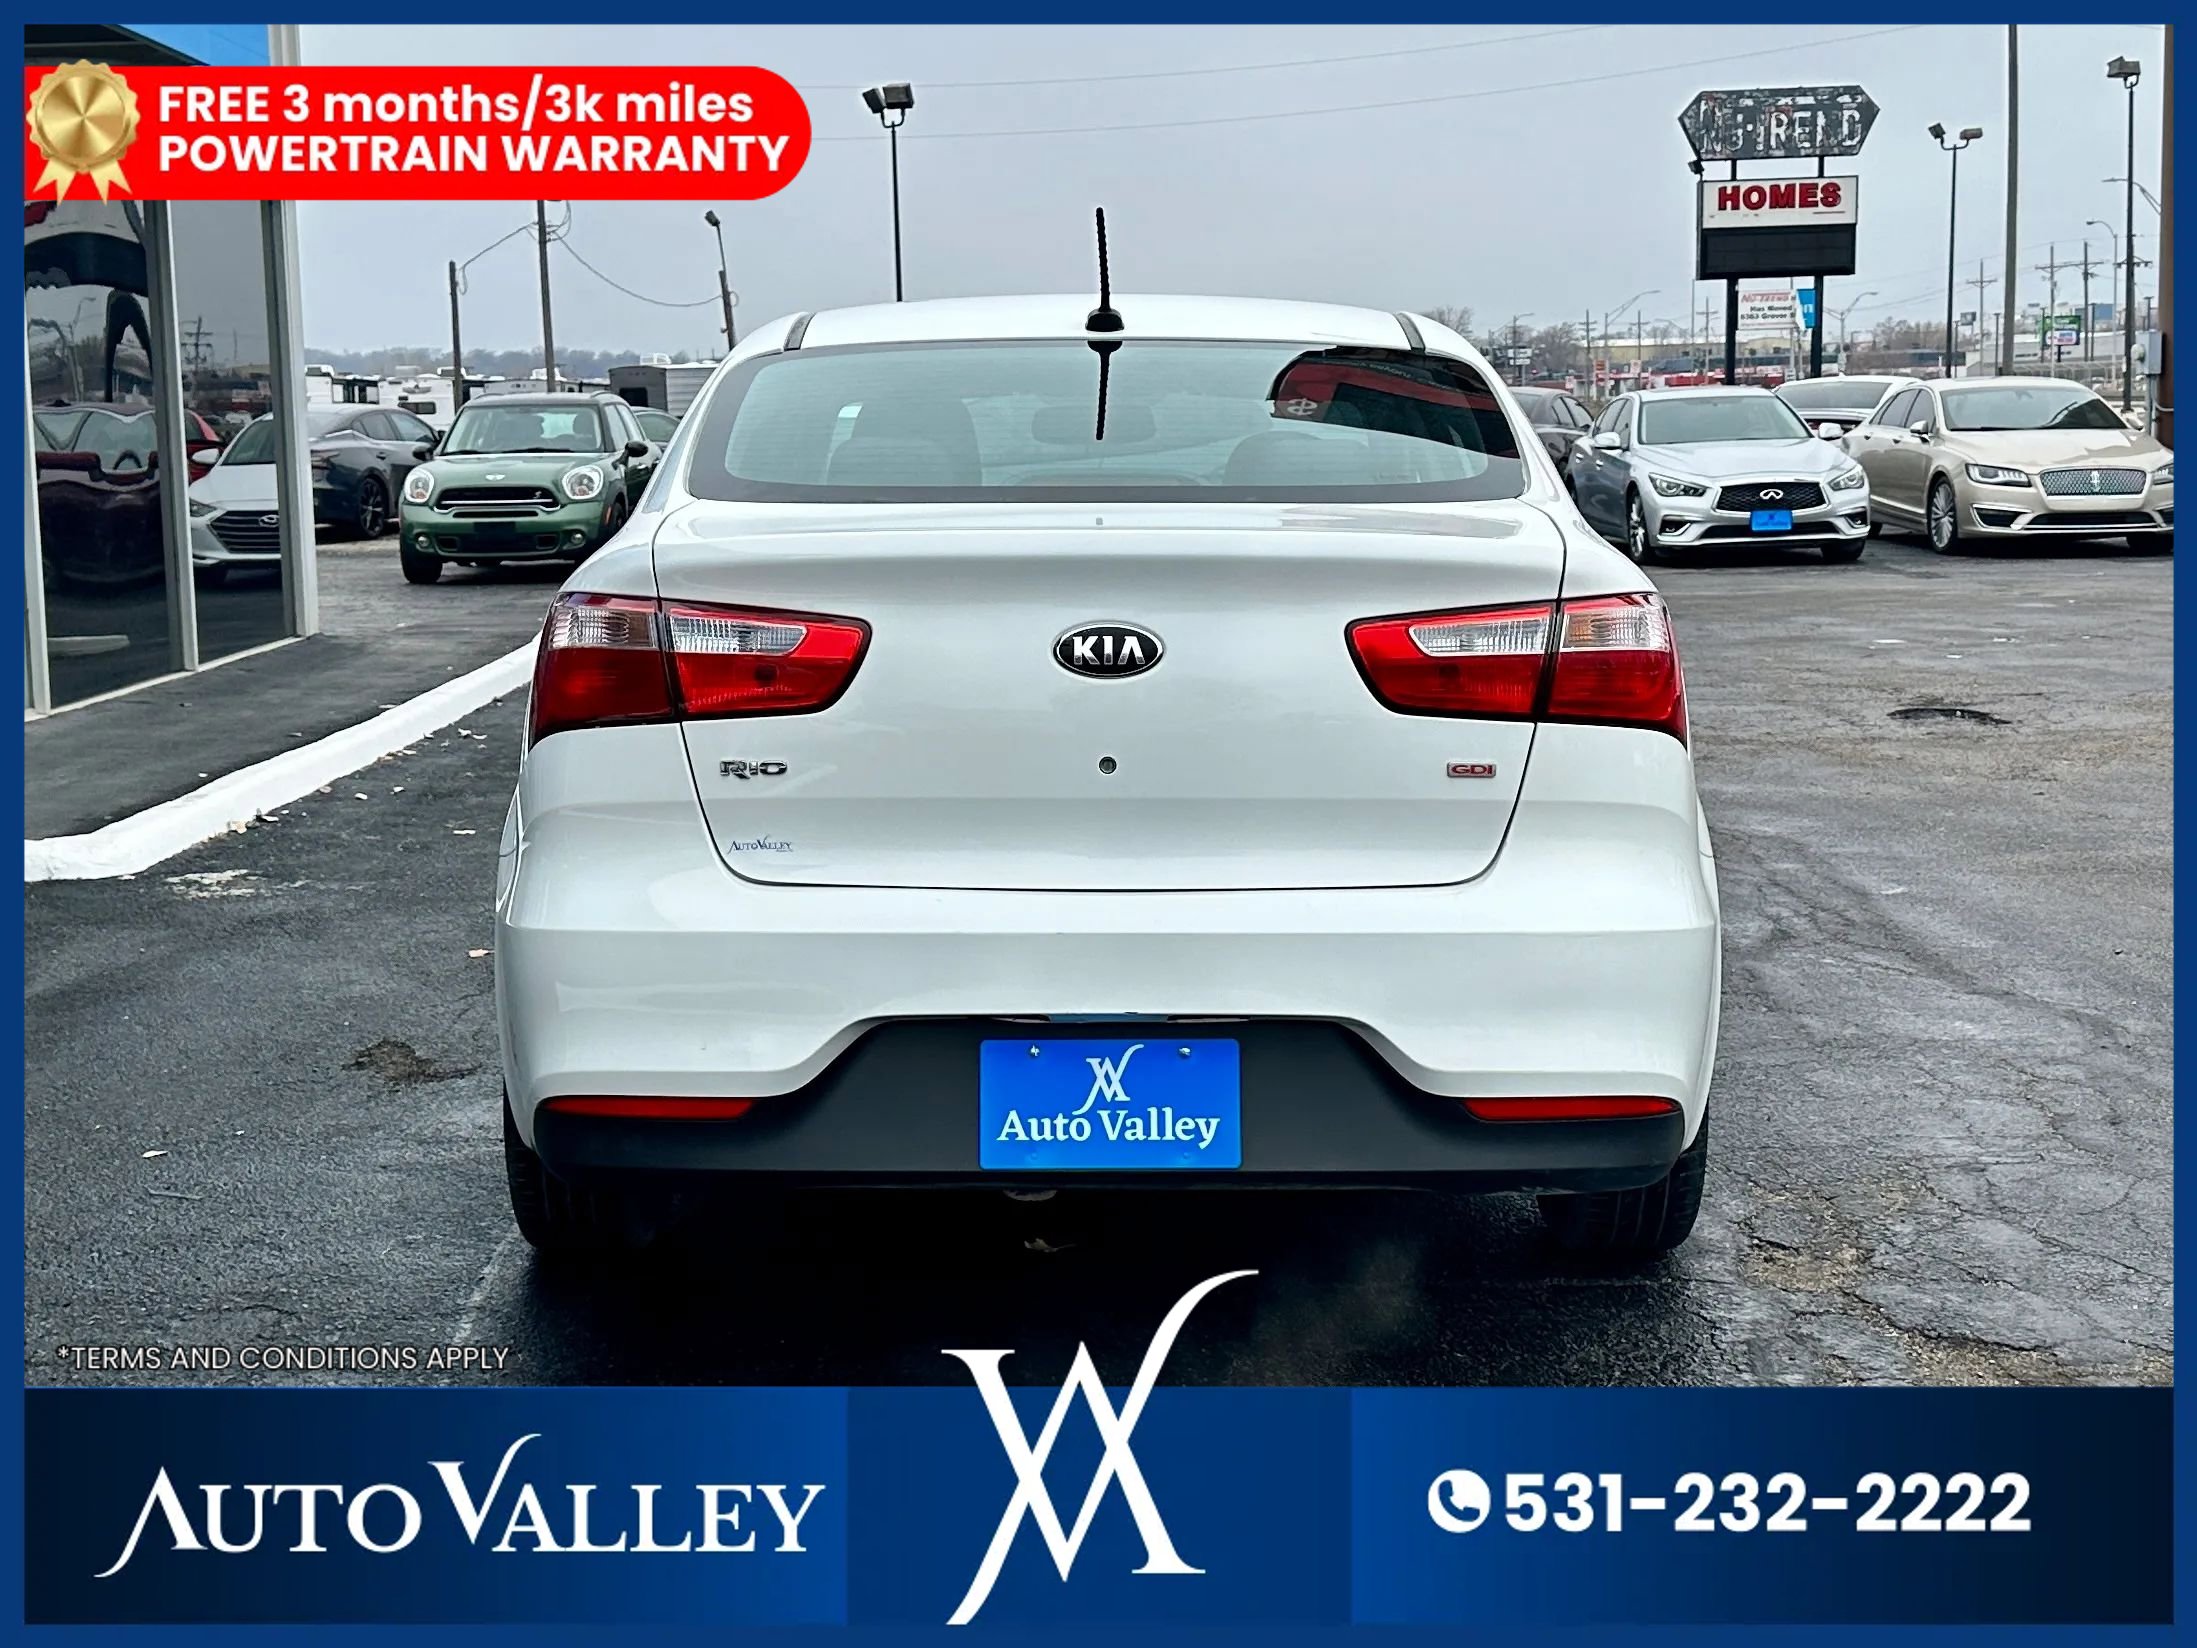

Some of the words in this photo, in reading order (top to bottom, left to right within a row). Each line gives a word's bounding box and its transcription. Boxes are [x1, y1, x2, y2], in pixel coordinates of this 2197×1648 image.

[1718, 182, 1842, 211] HOMES
[1072, 635, 1146, 665] KIA
[720, 760, 788, 779] RIO
[1451, 764, 1493, 775] GDI
[997, 1110, 1092, 1142] Auto
[1097, 1107, 1221, 1150] Valley
